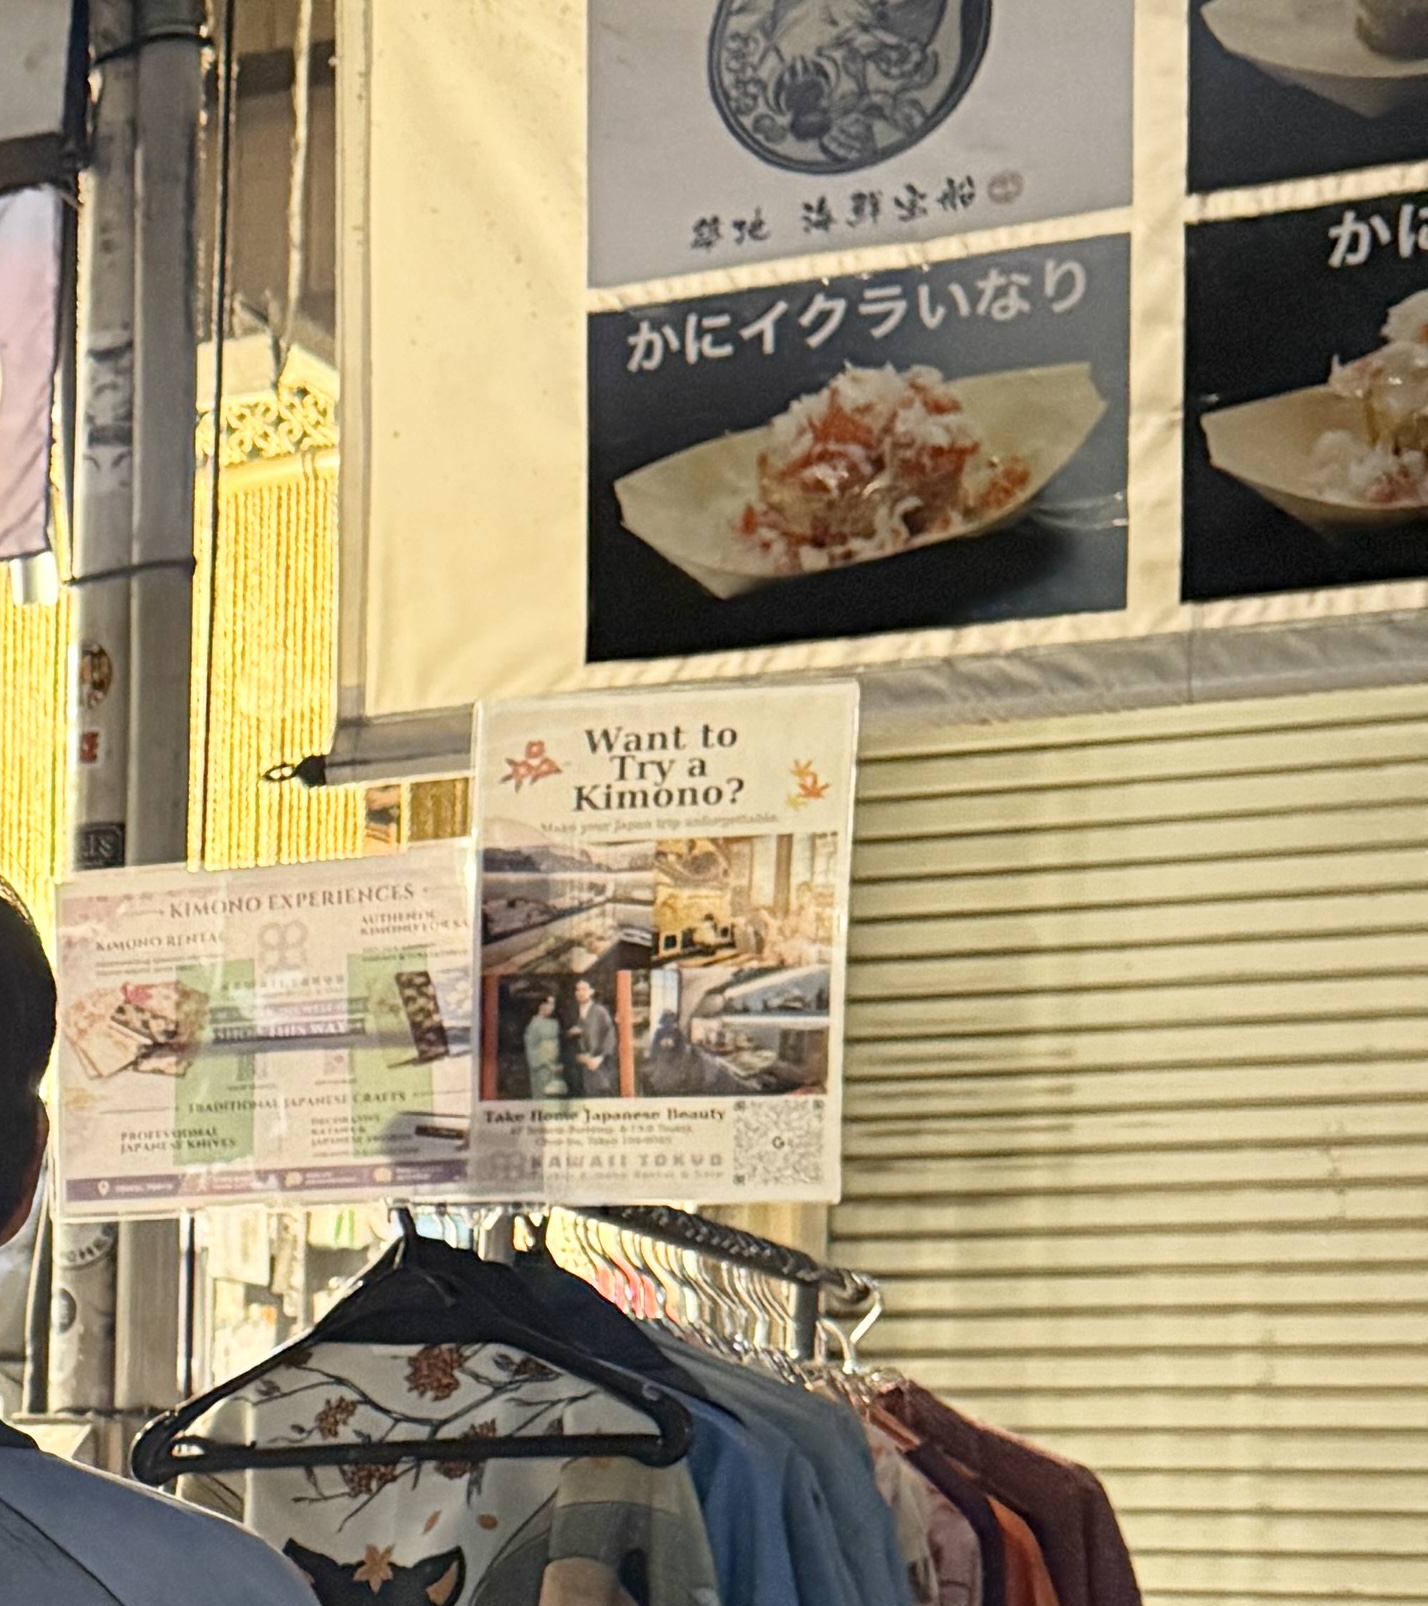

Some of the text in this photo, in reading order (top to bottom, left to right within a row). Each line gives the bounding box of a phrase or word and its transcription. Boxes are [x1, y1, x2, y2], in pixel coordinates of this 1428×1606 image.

[626, 258, 1087, 376] かにイクラいなり
[584, 723, 738, 755] Want to
[610, 755, 707, 786] Try a
[572, 777, 745, 812] Kimono?
[170, 884, 414, 919] KIMONO EXPERIENCES
[484, 1106, 727, 1124] Take Home Japanese Beauty
